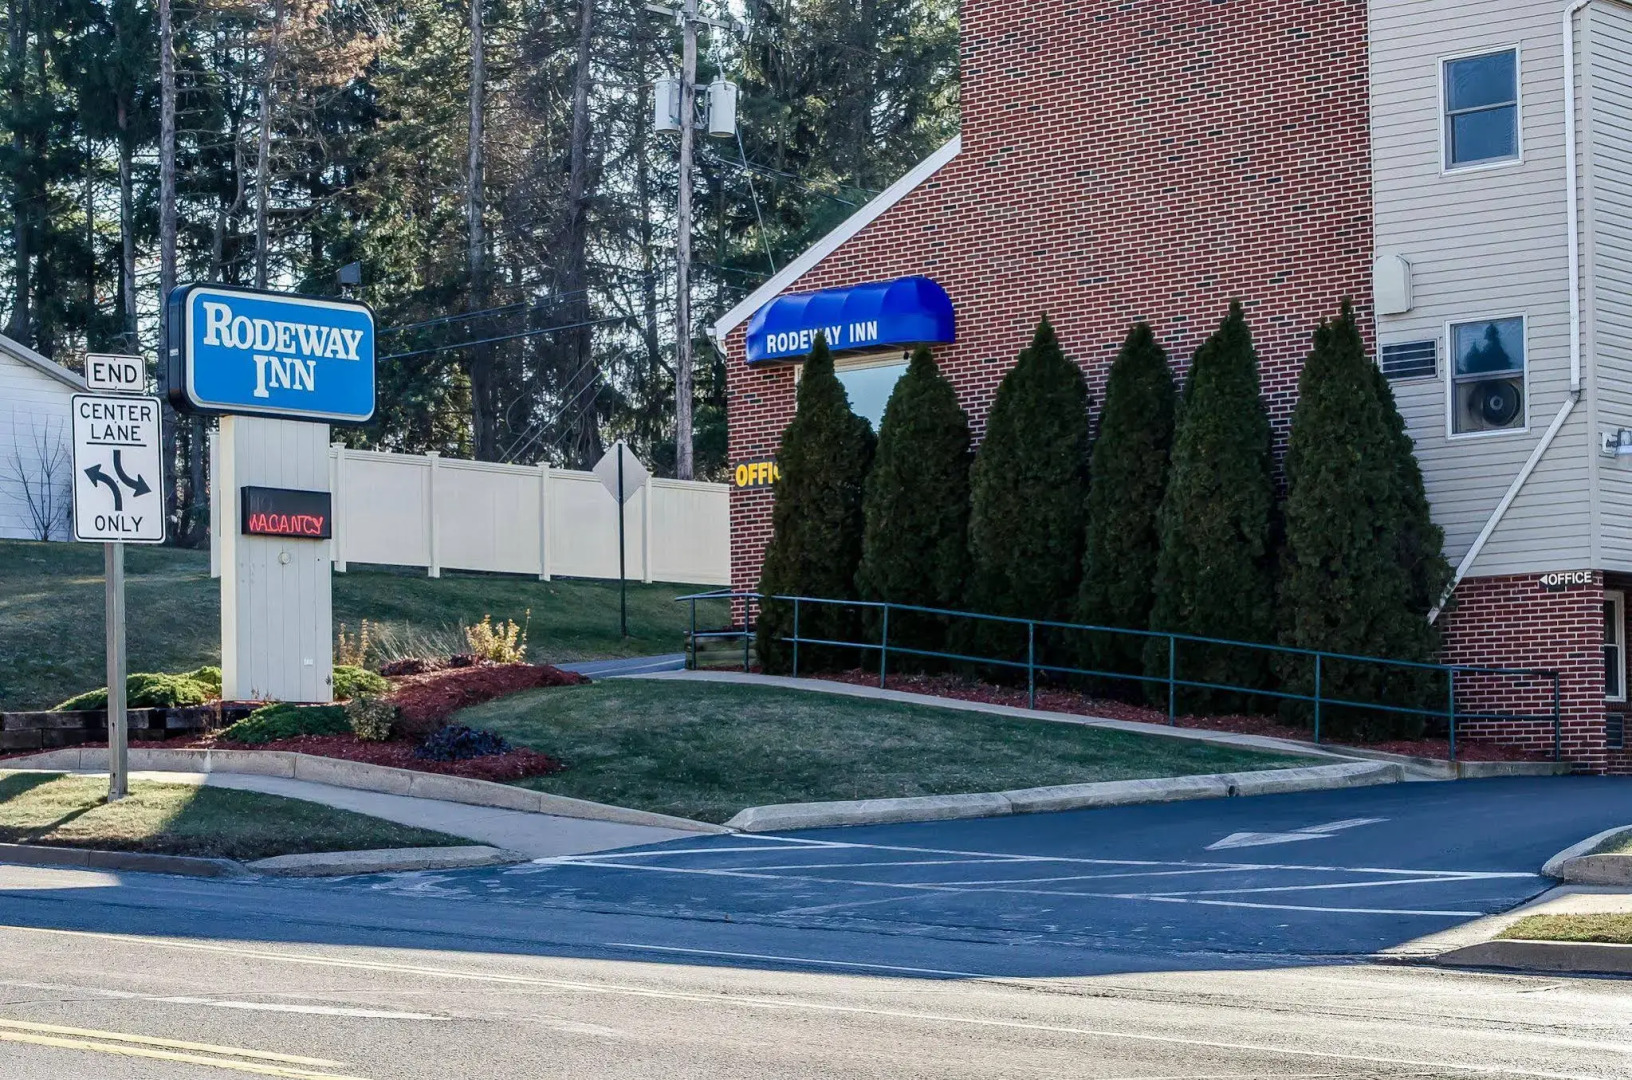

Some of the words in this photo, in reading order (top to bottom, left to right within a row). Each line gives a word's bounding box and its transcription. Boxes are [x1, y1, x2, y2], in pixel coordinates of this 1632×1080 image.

[849, 320, 878, 343] INN
[93, 363, 138, 383] END
[253, 355, 317, 398] INN
[80, 402, 151, 422] CENTER
[91, 425, 141, 441] LANE
[95, 515, 144, 533] ONLY
[249, 513, 324, 535] VACANCY
[1548, 571, 1593, 586] OFFICE
